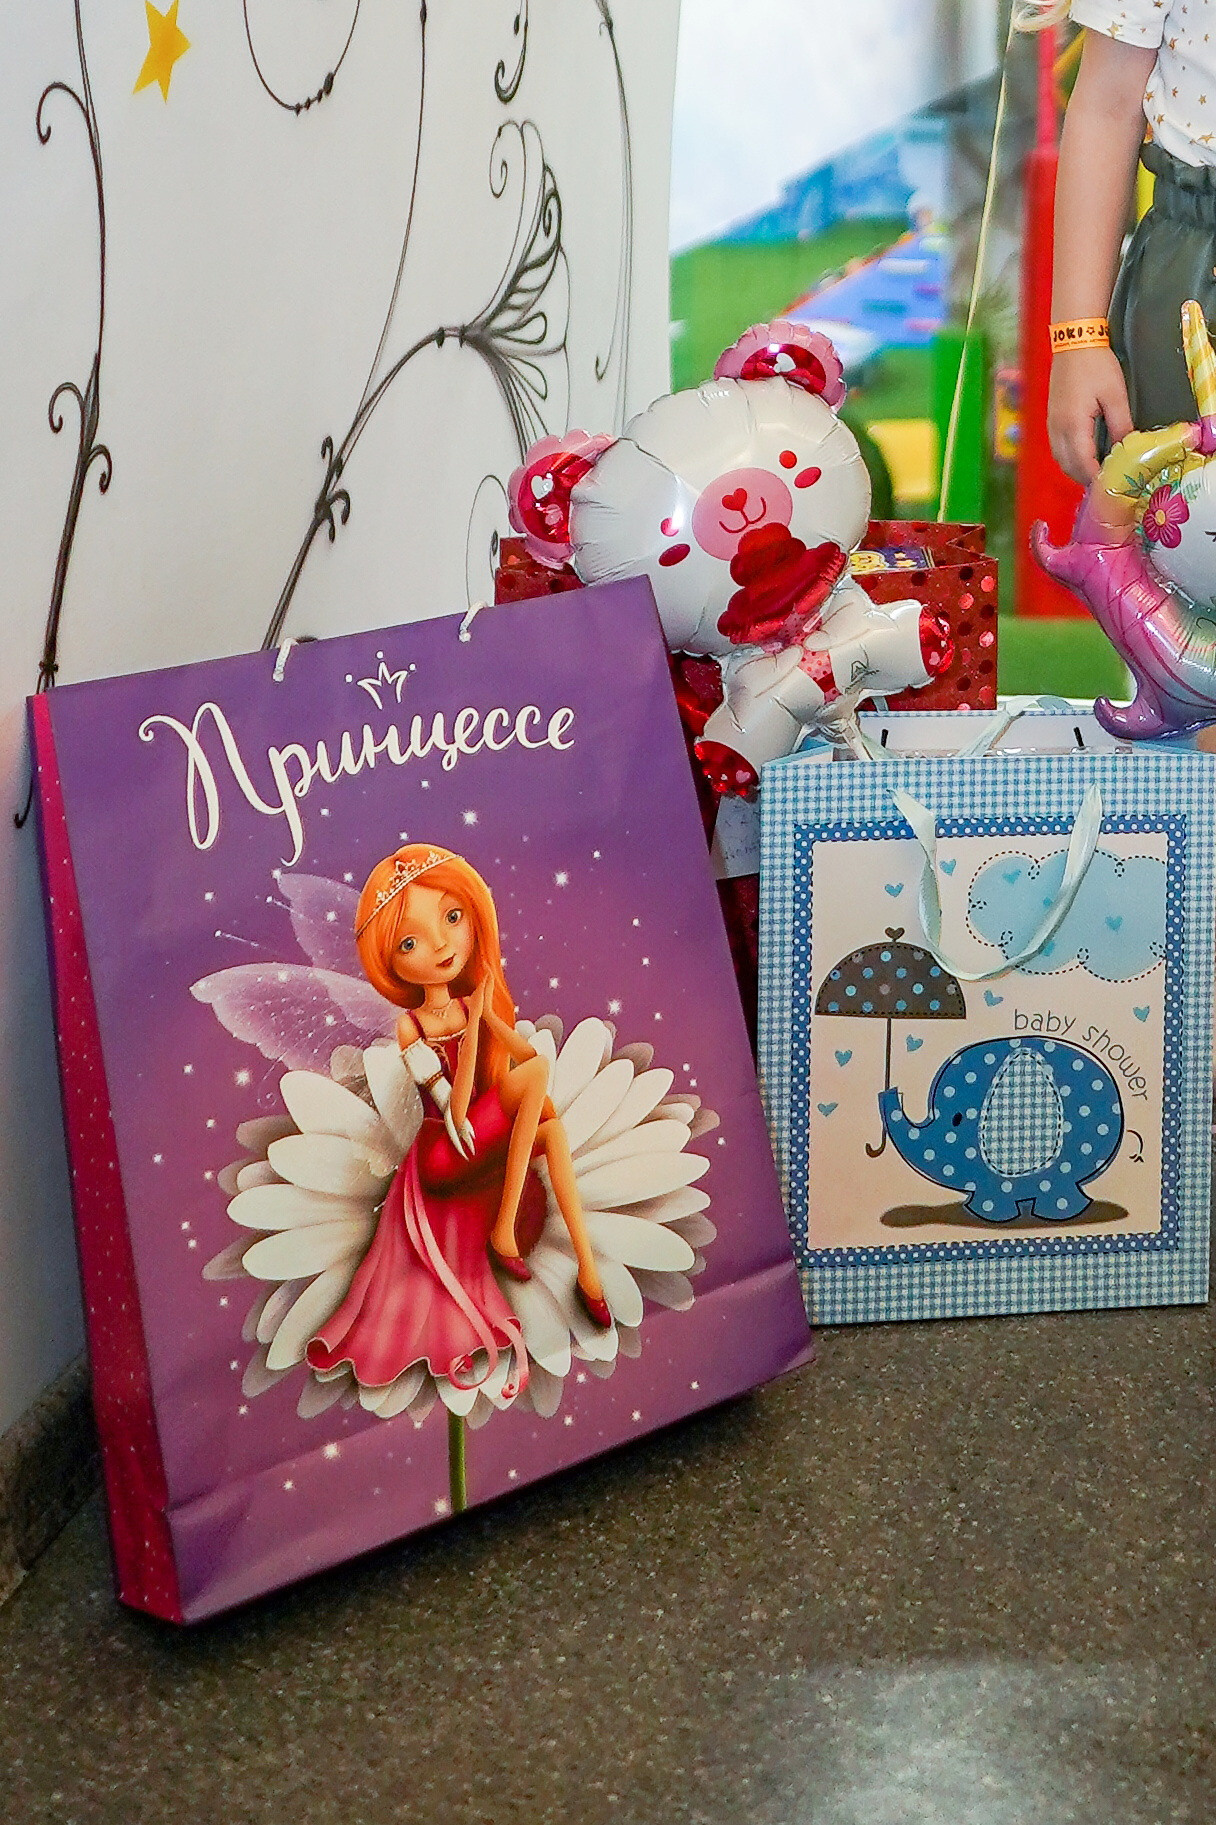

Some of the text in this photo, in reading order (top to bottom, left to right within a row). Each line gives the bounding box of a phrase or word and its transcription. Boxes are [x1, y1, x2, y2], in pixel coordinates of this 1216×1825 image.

[1053, 326, 1083, 342] JOKI
[138, 702, 576, 866] Принцессе
[1014, 1008, 1148, 1101] baby shower
